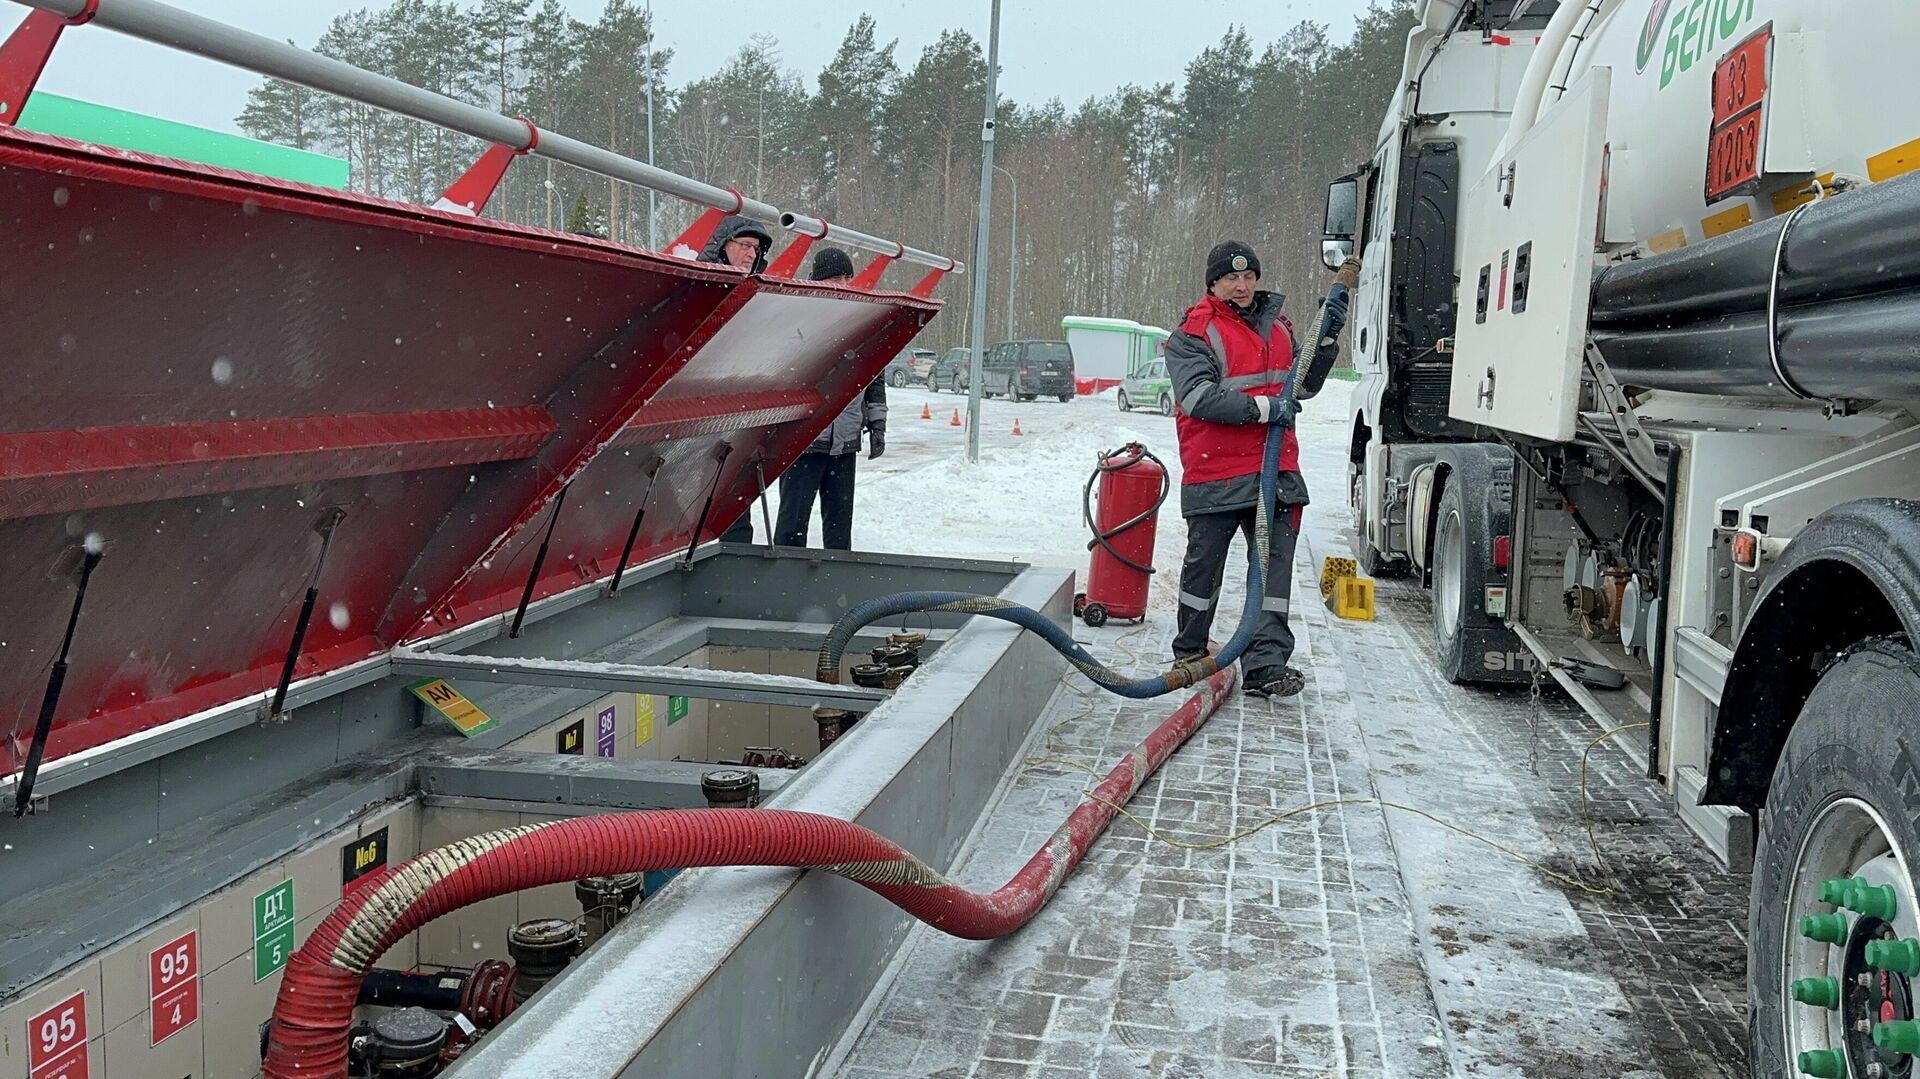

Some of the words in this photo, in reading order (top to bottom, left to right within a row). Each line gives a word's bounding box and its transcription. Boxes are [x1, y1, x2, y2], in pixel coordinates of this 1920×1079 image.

[1727, 53, 1747, 111] 33
[1717, 119, 1755, 186] 1203
[601, 712, 612, 733] 98
[356, 841, 376, 869] №6
[263, 888, 286, 923] ДТ
[160, 944, 188, 984] 95
[272, 944, 281, 965] 5
[41, 1007, 76, 1053] 95
[171, 1004, 181, 1025] 4
